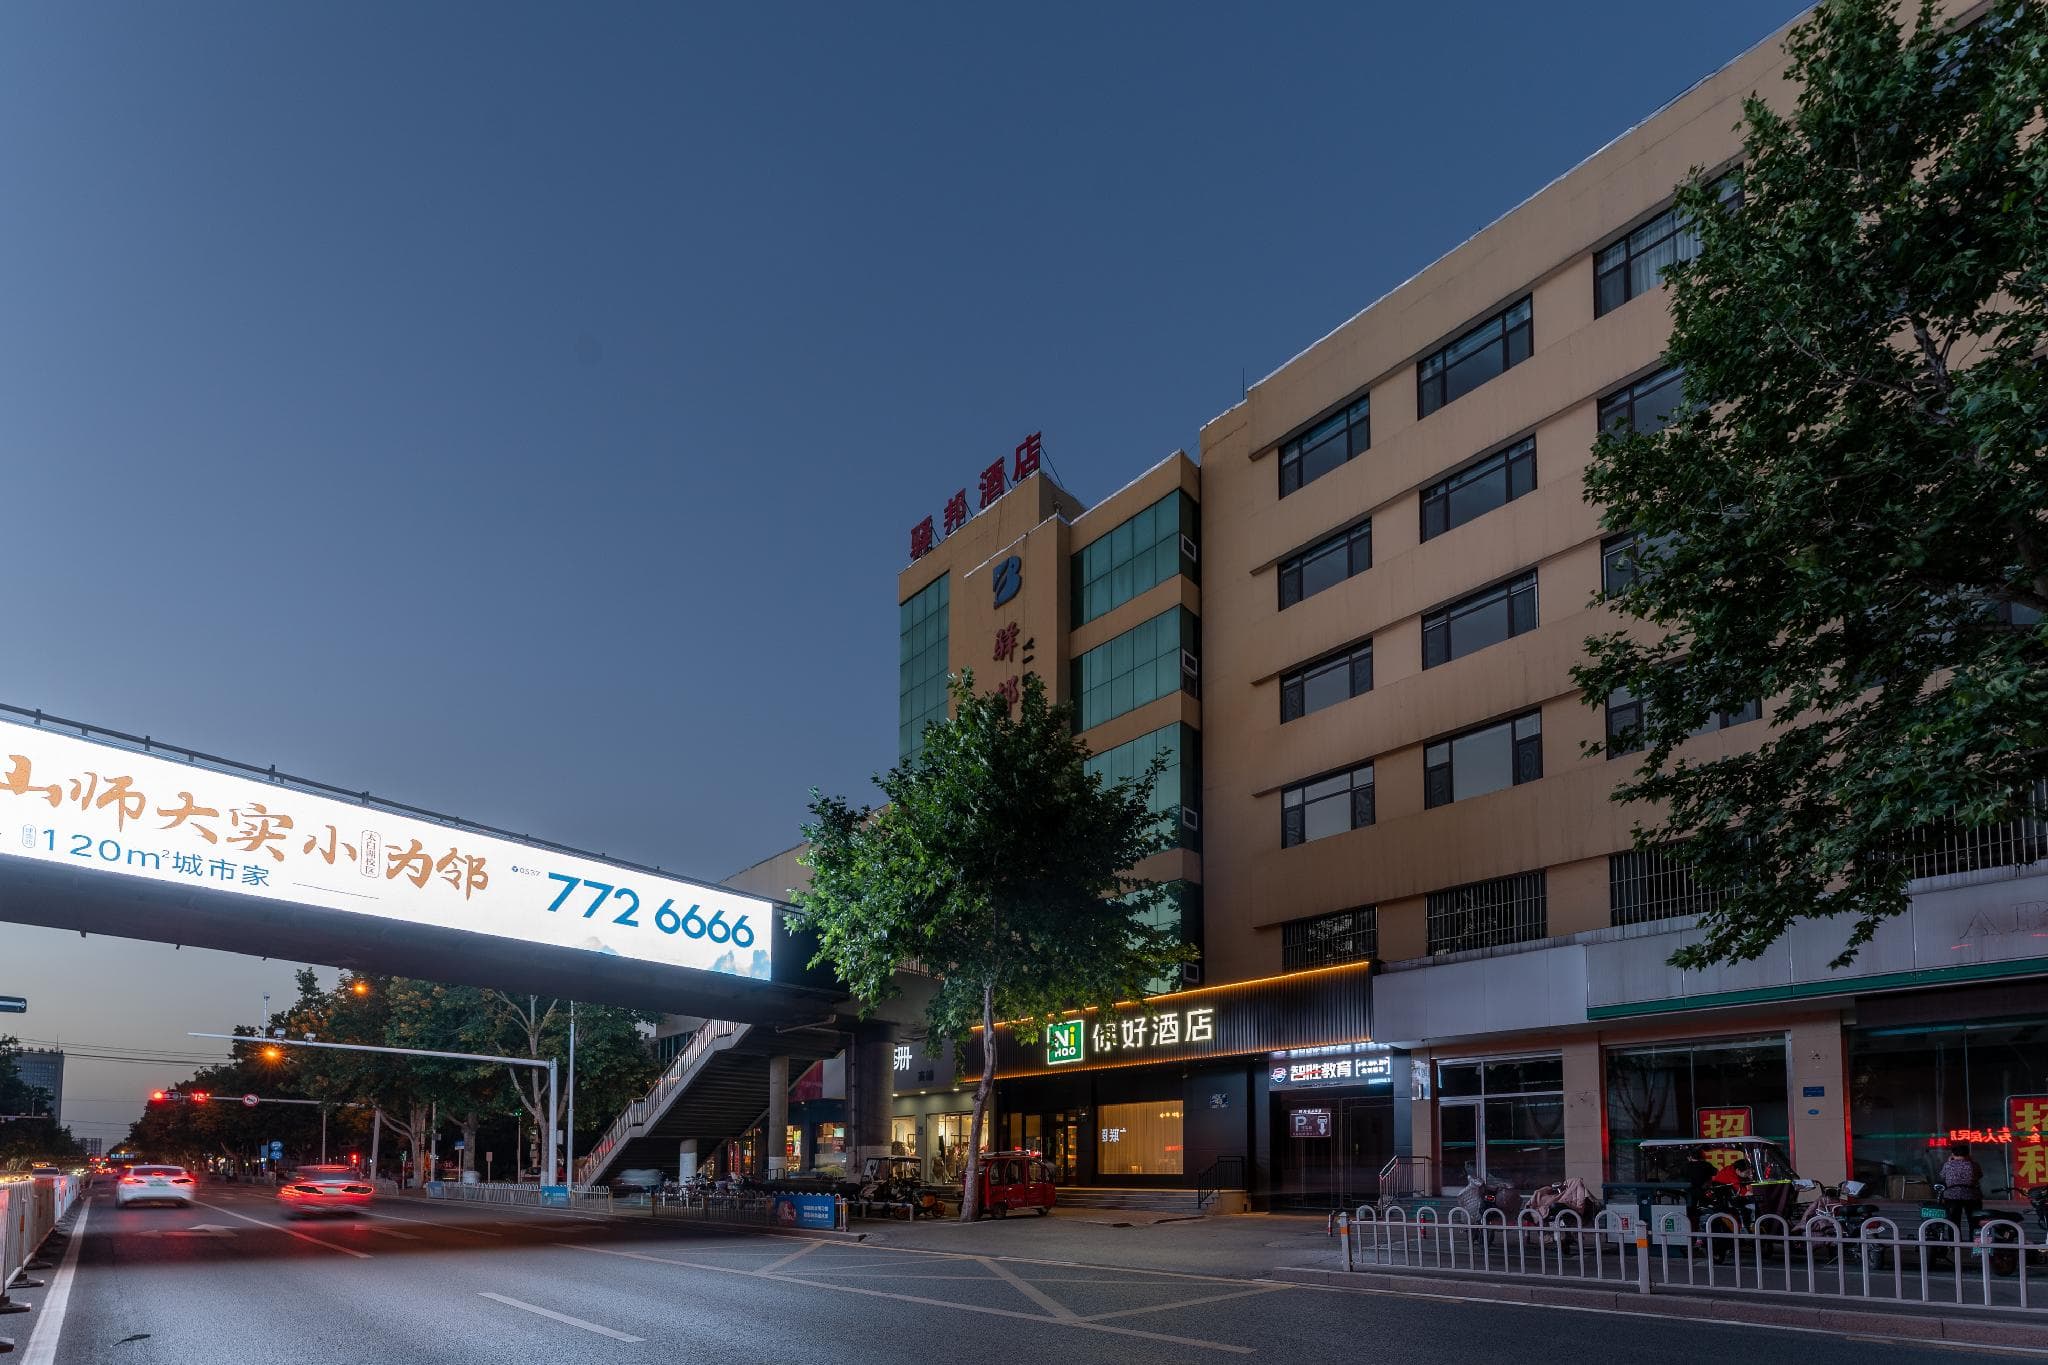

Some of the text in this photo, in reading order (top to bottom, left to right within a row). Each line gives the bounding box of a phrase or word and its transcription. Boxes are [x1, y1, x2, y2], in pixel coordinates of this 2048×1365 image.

[386, 838, 489, 901] 为邻
[547, 872, 640, 927] 772
[654, 898, 755, 948] 6666
